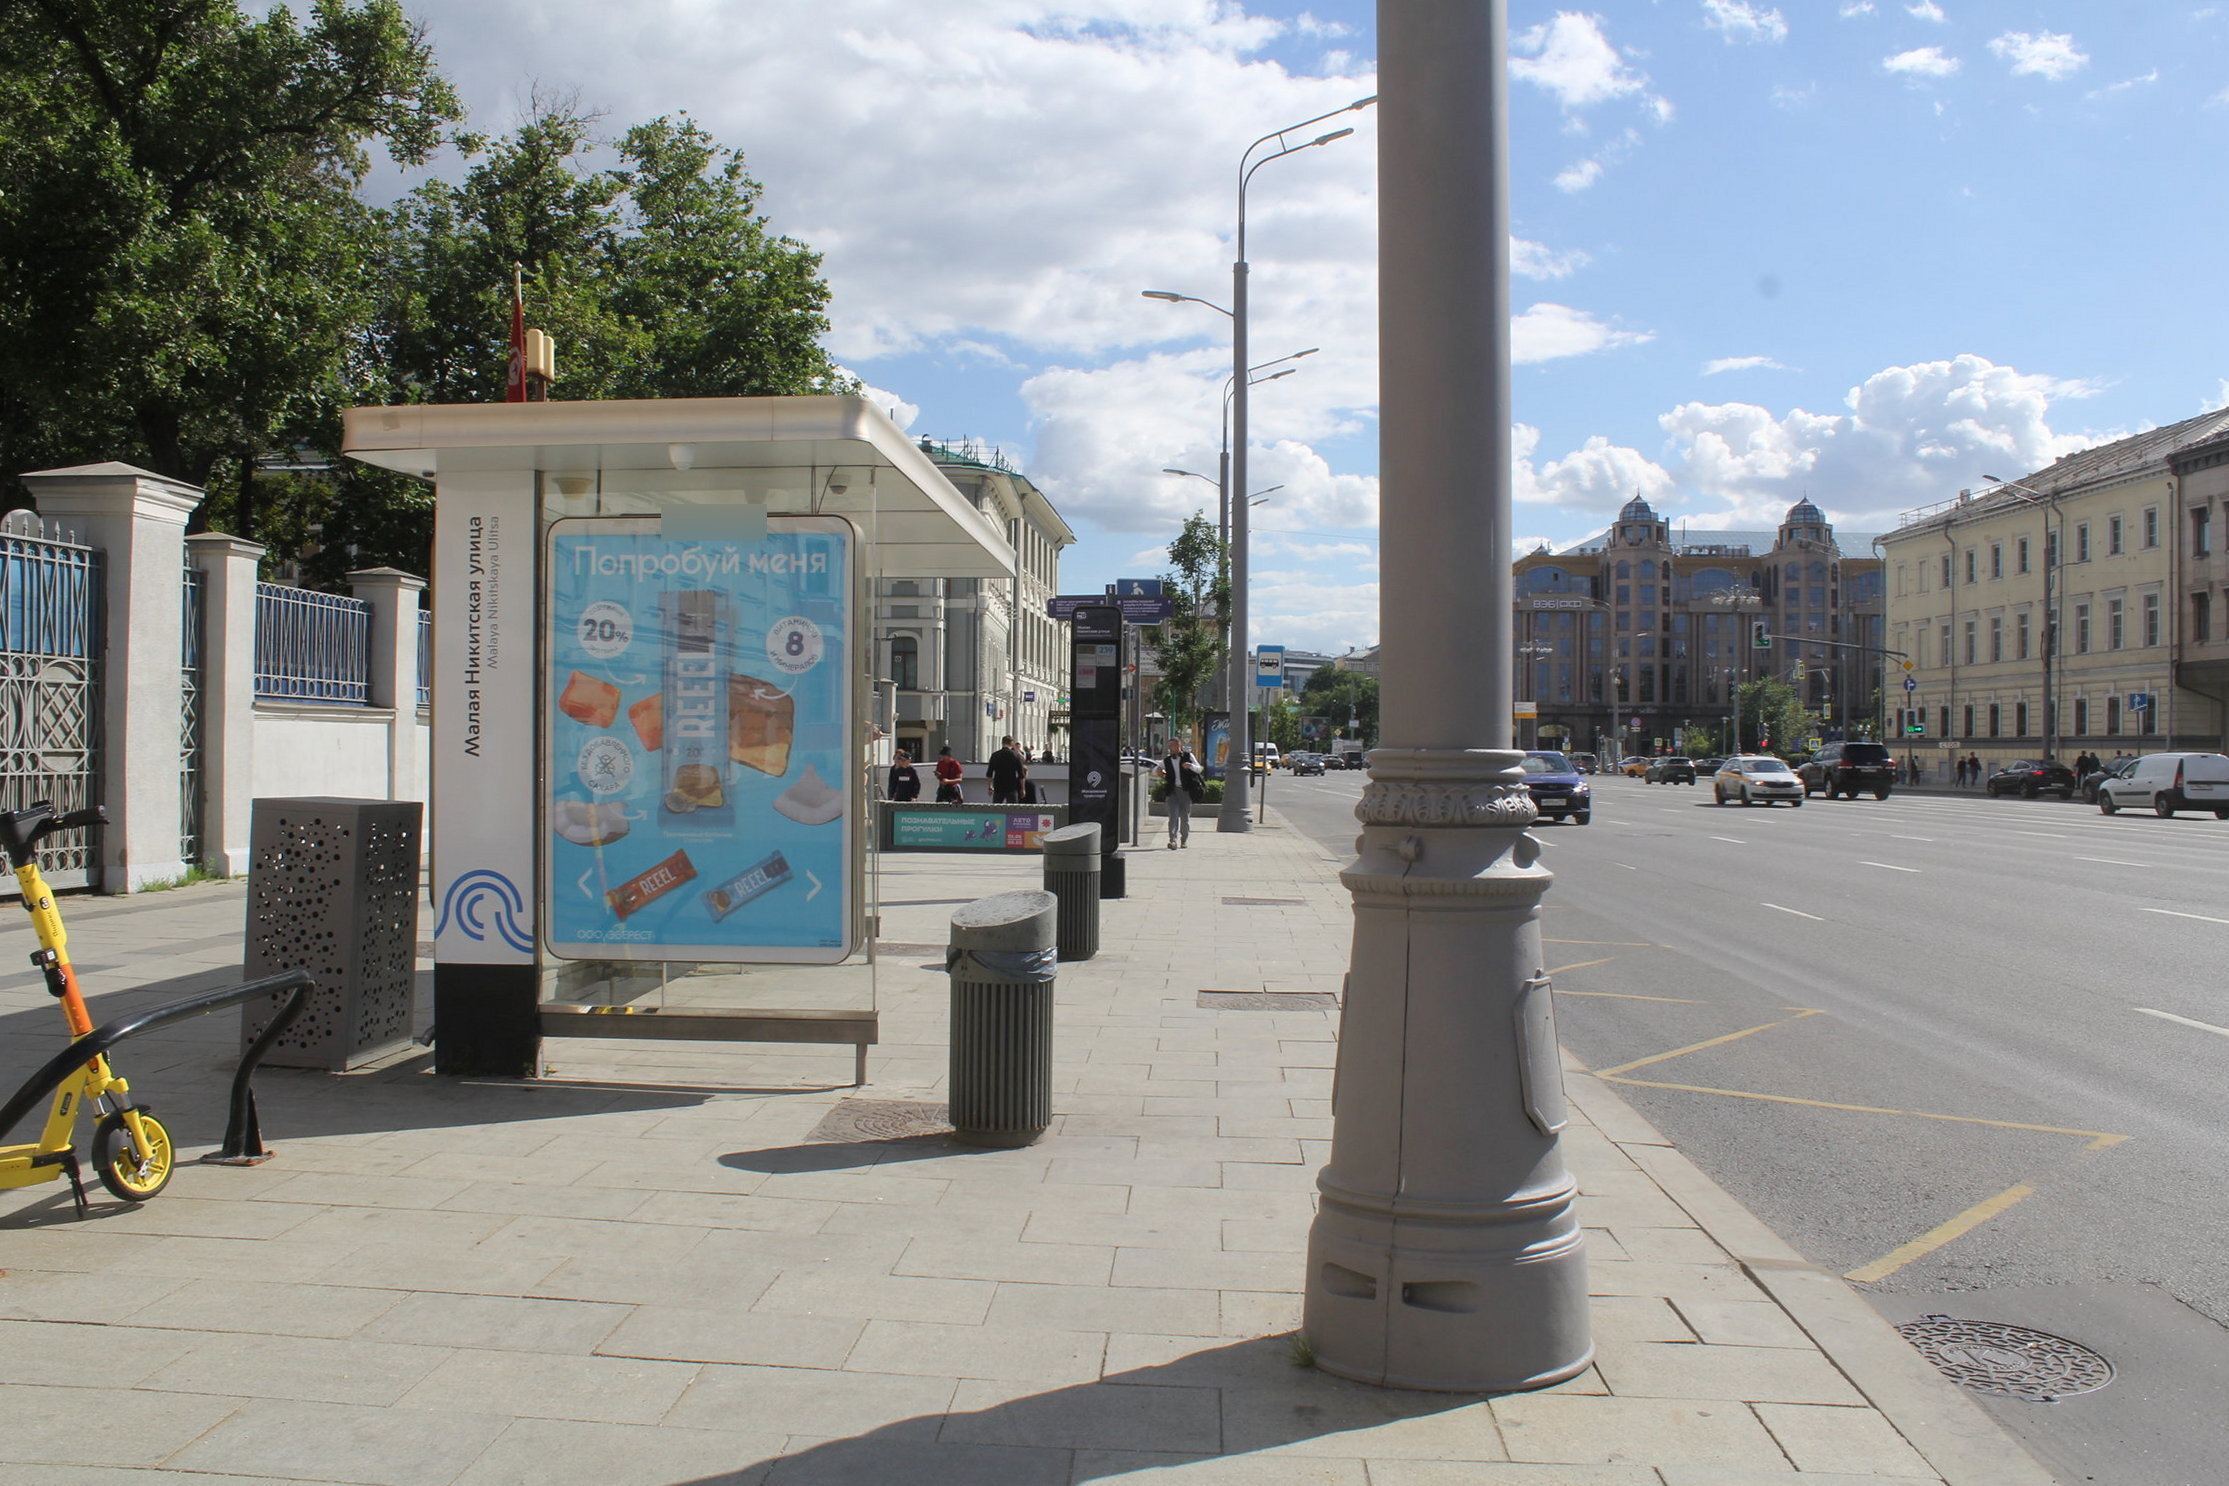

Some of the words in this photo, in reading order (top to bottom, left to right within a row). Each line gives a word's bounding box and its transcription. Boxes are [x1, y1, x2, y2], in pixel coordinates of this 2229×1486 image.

[468, 515, 485, 575] улица
[487, 515, 500, 551] Ulitsa
[573, 546, 742, 584] Попробуй
[750, 552, 828, 574] меня
[487, 554, 500, 620] Nikitskaya
[464, 580, 482, 684] Никитская
[487, 623, 500, 670] Malaya
[582, 618, 630, 643] 20%
[784, 630, 805, 657] 8
[677, 642, 716, 738] REEEL
[464, 689, 481, 758] Малая
[638, 866, 678, 896] REEEL
[734, 868, 773, 898] REEEL
